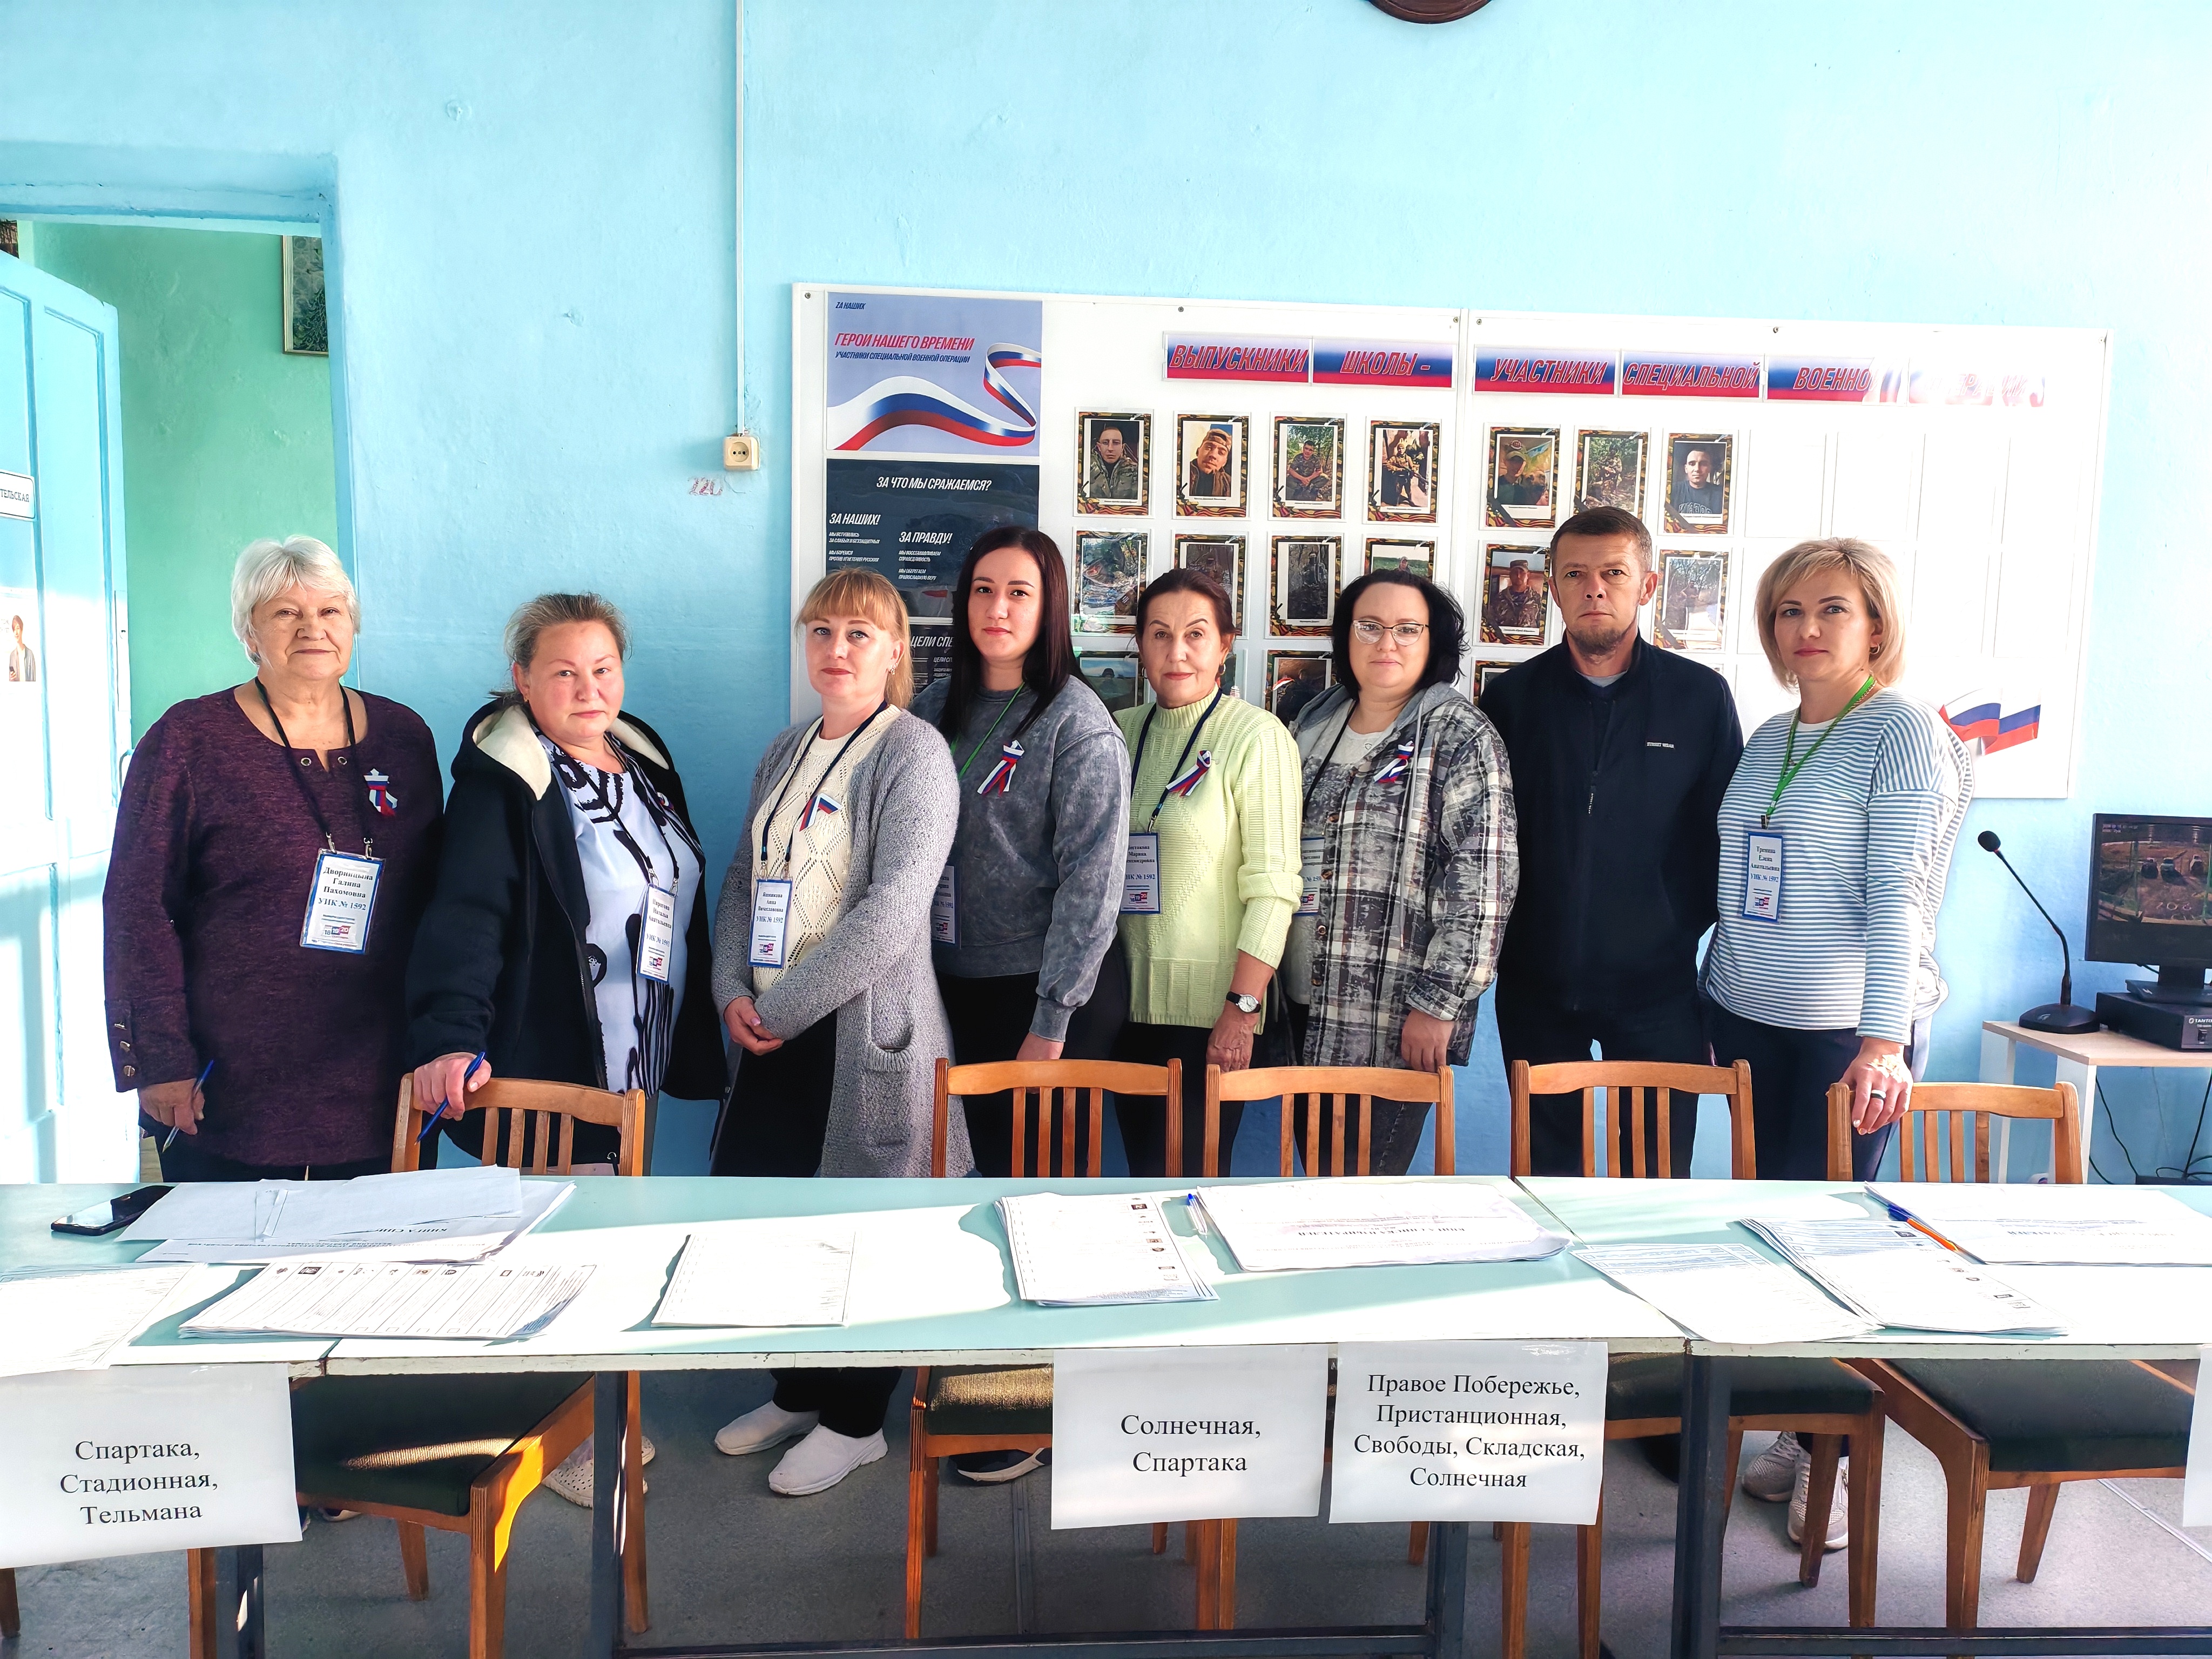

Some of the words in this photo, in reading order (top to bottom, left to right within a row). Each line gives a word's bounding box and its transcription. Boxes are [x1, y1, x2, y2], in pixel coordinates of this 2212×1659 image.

[834, 333, 873, 347] ГЕРОИ
[872, 334, 920, 349] НАШЕГО
[920, 336, 975, 351] ВРЕМЕНИ
[835, 351, 869, 359] УЧАСТНИКИ
[869, 352, 913, 361] СПЕЦИАЛЬНОЙ
[912, 354, 940, 362] ВОЕННОЙ
[1169, 344, 1309, 373] ВЫПУСКНИКИ
[1340, 350, 1418, 376] ШКОЛЫ
[1491, 358, 1608, 385] УЧАСТНИКИ
[1623, 362, 1761, 391] СПЕЦИАЛЬНОЙ
[876, 477, 889, 488] ЗА
[891, 477, 910, 489] ЧТО
[909, 478, 928, 489] МЫ
[928, 479, 992, 491] СРАЖАЕМСЯ?
[829, 514, 841, 524] ЗА
[842, 514, 881, 525] НАШИХ!
[899, 532, 912, 543] ЗА
[912, 532, 953, 545] ПРАВДУ!
[911, 636, 936, 648] ЦЕЛИ
[323, 886, 366, 898] Пахомовна
[333, 878, 361, 888] Галина
[318, 898, 338, 907] УИК
[350, 902, 367, 911] 1592
[1367, 1374, 1446, 1397] Правое
[1452, 1375, 1580, 1399] Побережье,
[1121, 1414, 1261, 1439] Солнечная,
[1376, 1405, 1566, 1429] Пристанционная,
[75, 1440, 200, 1464] Спартака,
[1354, 1434, 1458, 1459] Свободы,
[1466, 1437, 1585, 1461] Складская,
[1133, 1452, 1247, 1477] Спартака
[60, 1473, 218, 1494] Стадионная,
[1410, 1467, 1527, 1488] Солнечная
[80, 1505, 203, 1525] Тельмана
